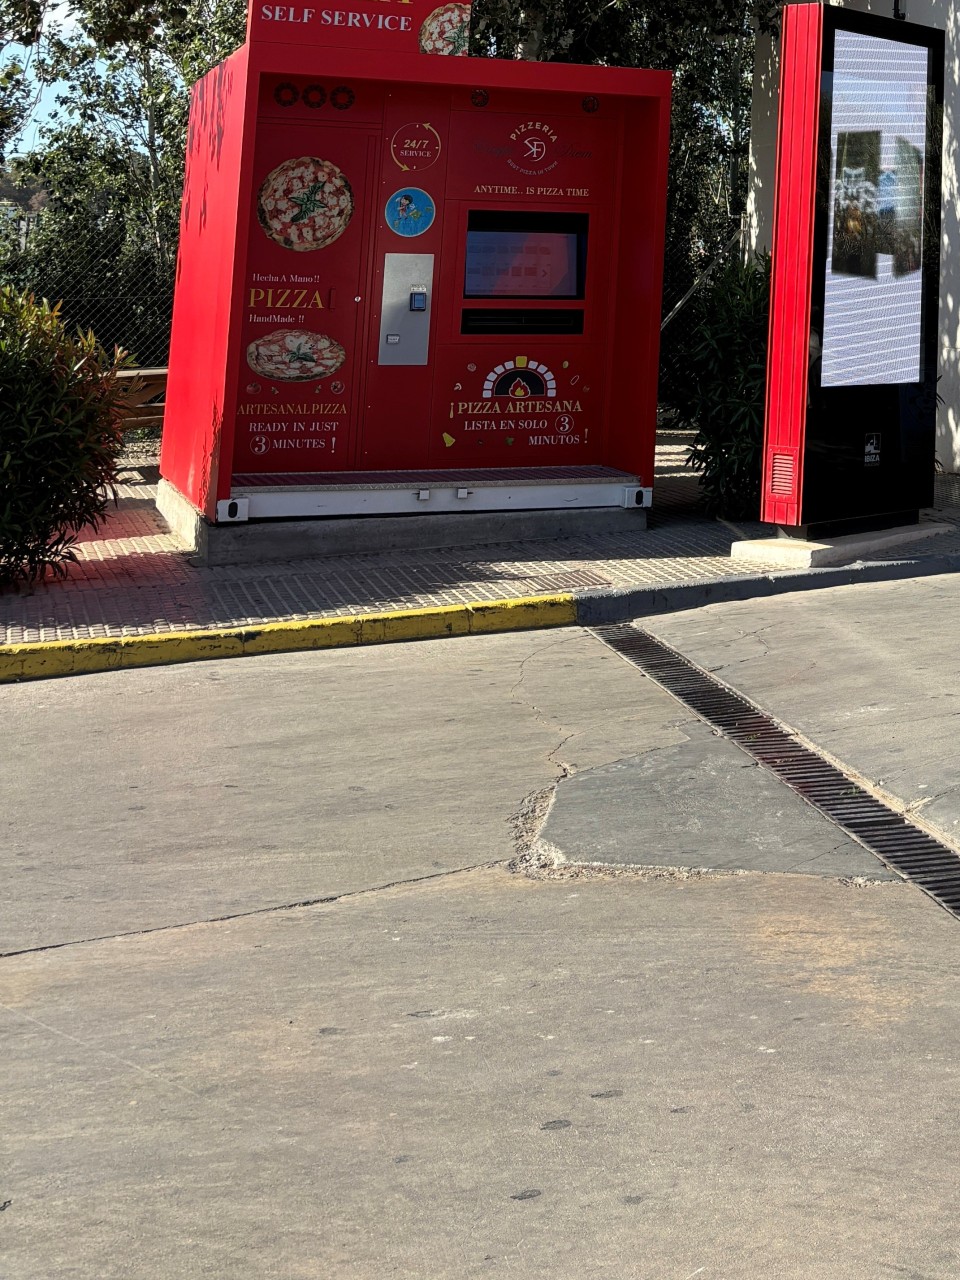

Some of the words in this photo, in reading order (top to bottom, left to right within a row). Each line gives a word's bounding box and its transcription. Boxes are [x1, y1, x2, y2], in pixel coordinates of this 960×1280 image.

[261, 4, 315, 23] SELF
[321, 9, 412, 31] SERVICE
[510, 121, 558, 143] PIZZERIA
[403, 139, 429, 149] 24/7
[400, 149, 432, 158] SERVICE
[526, 186, 535, 195] IS
[537, 187, 564, 196] PIZZA
[566, 188, 589, 197] TIME
[252, 273, 279, 282] Hecha
[280, 274, 287, 282] A
[248, 288, 325, 309] PIZZA
[249, 314, 295, 323] HandMade
[237, 403, 310, 415] ARTESANAL
[311, 403, 347, 414] PIZZA
[505, 400, 583, 414] ARTESANA
[249, 422, 289, 432] READY
[293, 422, 306, 431] IN
[309, 421, 339, 432] JUST
[464, 420, 496, 431] LISTA
[500, 420, 516, 429] EN
[518, 419, 548, 429] SOLO
[559, 416, 570, 432] 3
[254, 436, 266, 453] 3
[272, 439, 326, 449] MINUTES
[528, 434, 580, 446] MINUTOS
